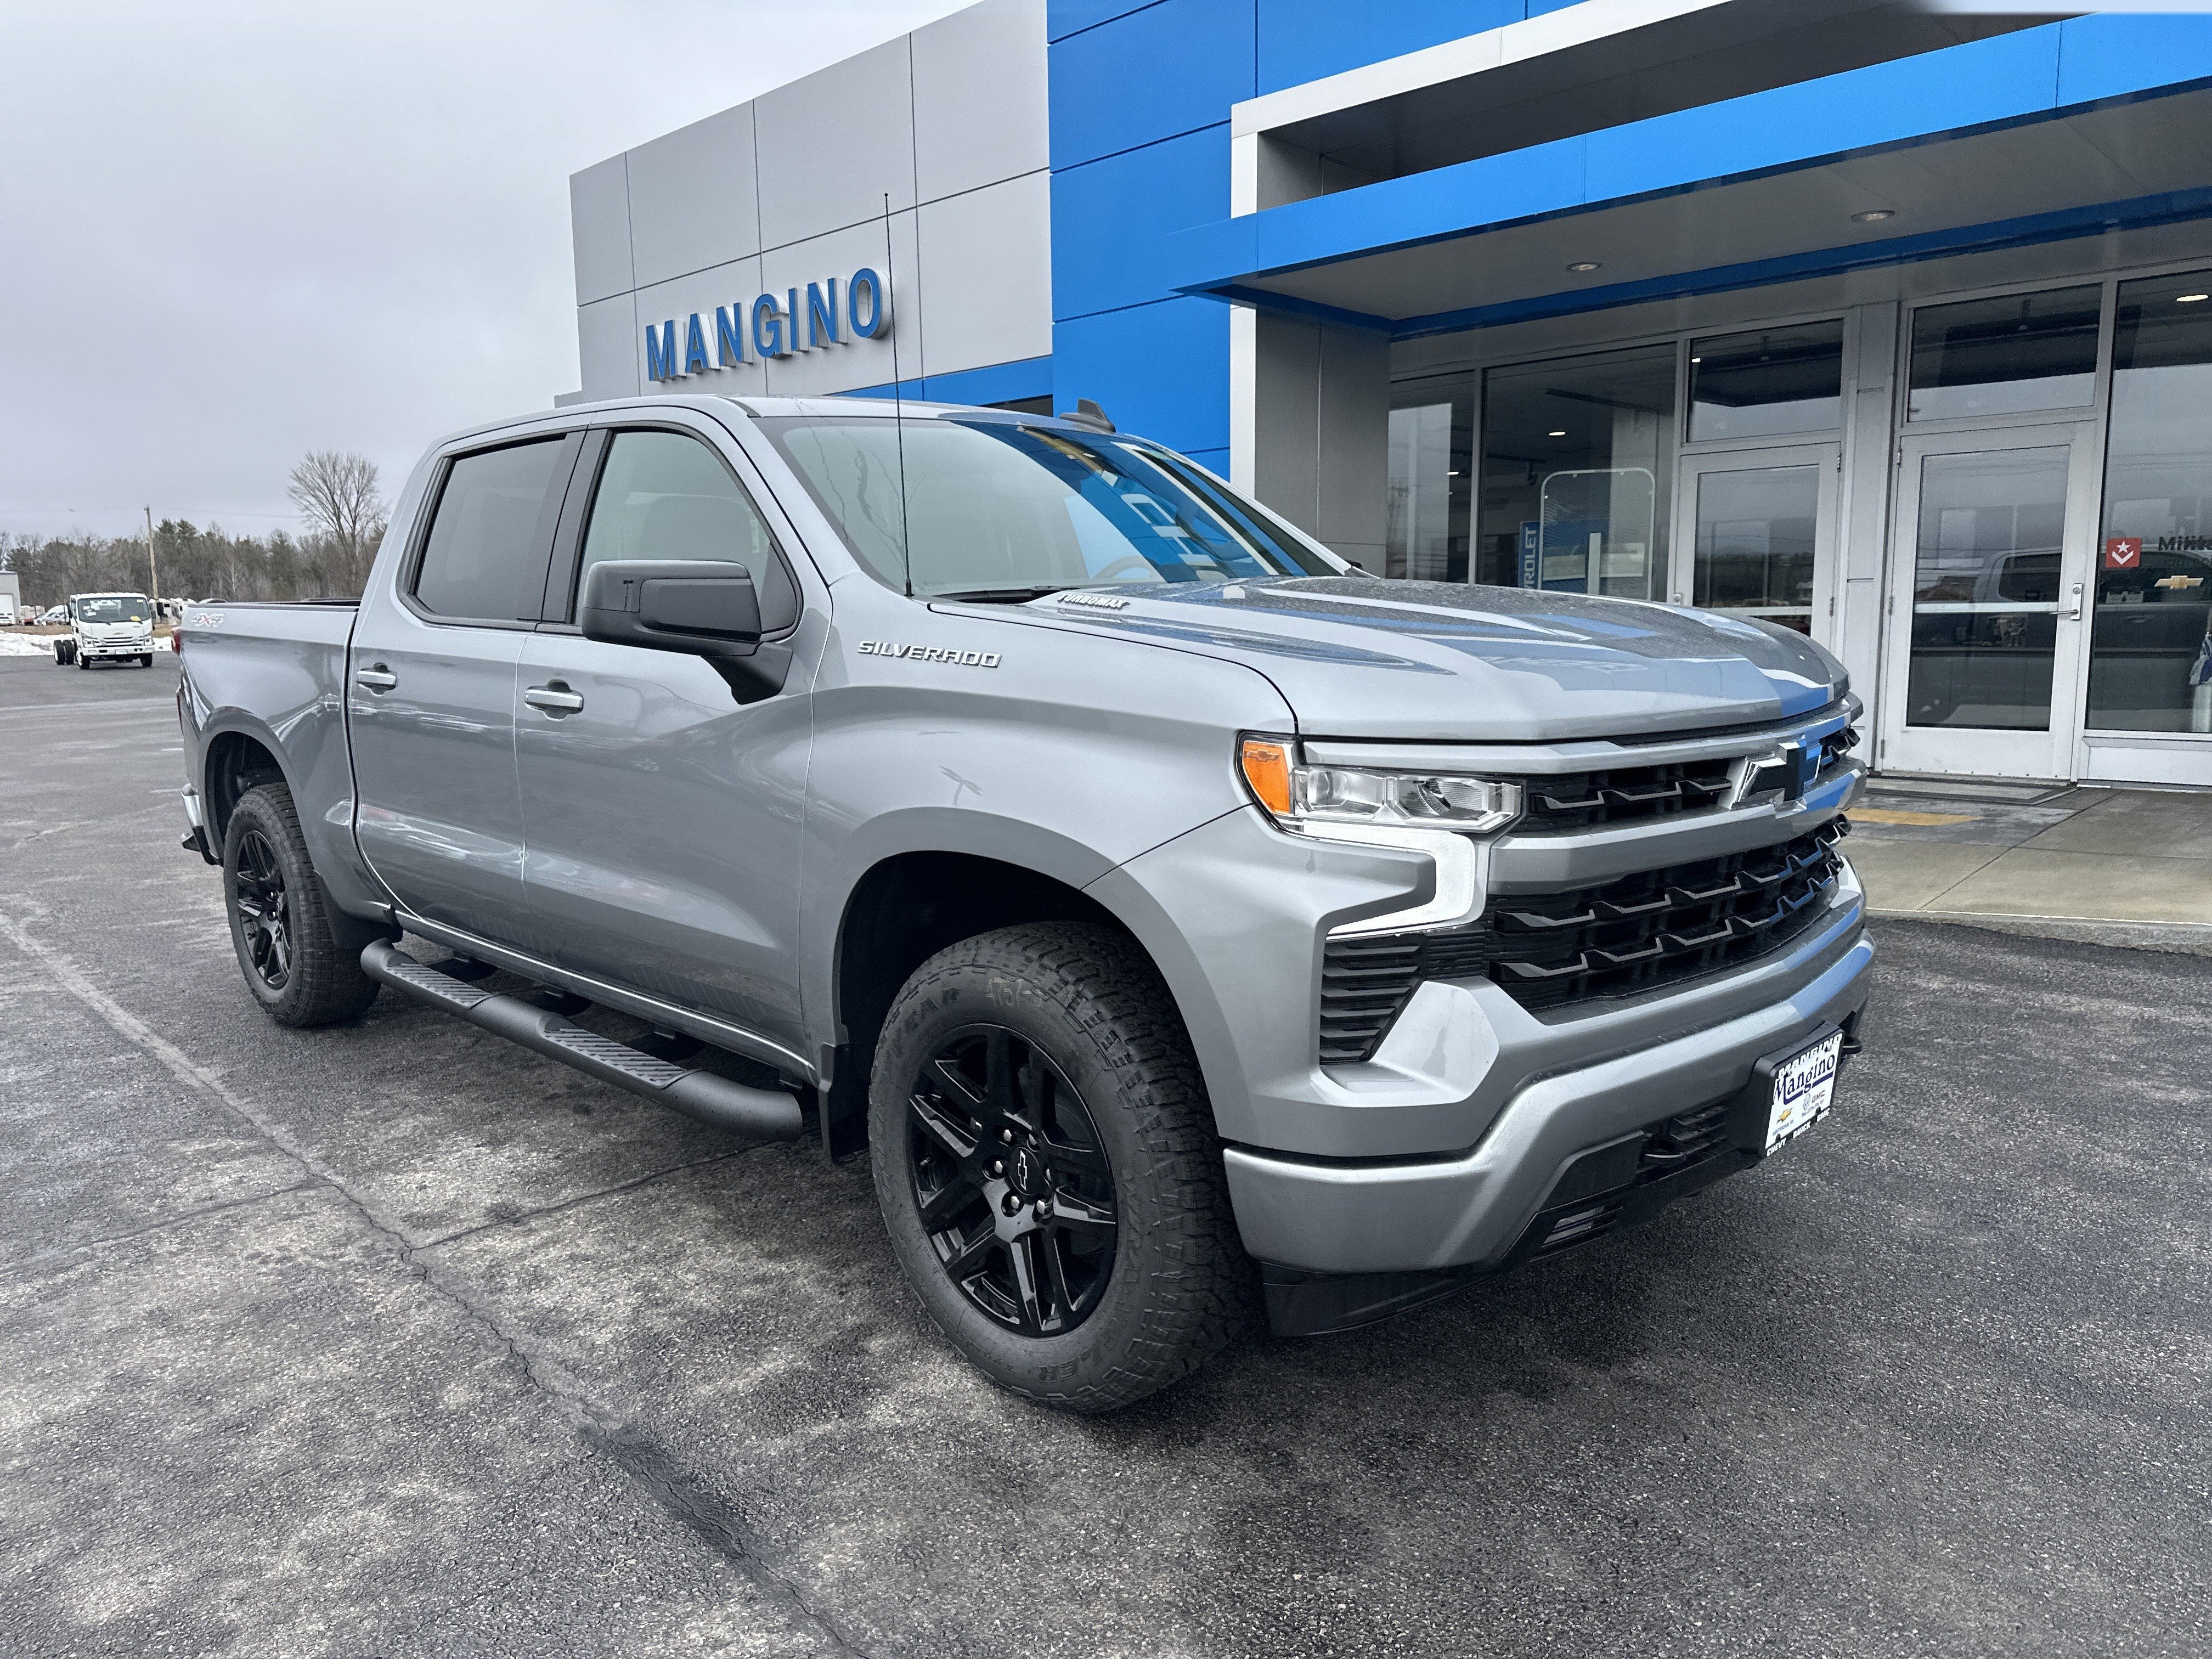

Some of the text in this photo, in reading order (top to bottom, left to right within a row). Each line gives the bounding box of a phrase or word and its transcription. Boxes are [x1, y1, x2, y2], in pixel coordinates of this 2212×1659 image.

[646, 267, 891, 382] MANGINO
[1057, 593, 1131, 610] TURBOMAX
[856, 640, 1002, 669] SILVERADO
[1778, 1032, 1843, 1079] MANGINO
[1773, 1054, 1835, 1105] Mangino
[1812, 1088, 1826, 1104] GMC
[1766, 1137, 1787, 1158] CHEVY
[1792, 1120, 1811, 1139] BUICK
[1816, 1108, 1830, 1122] GMC
